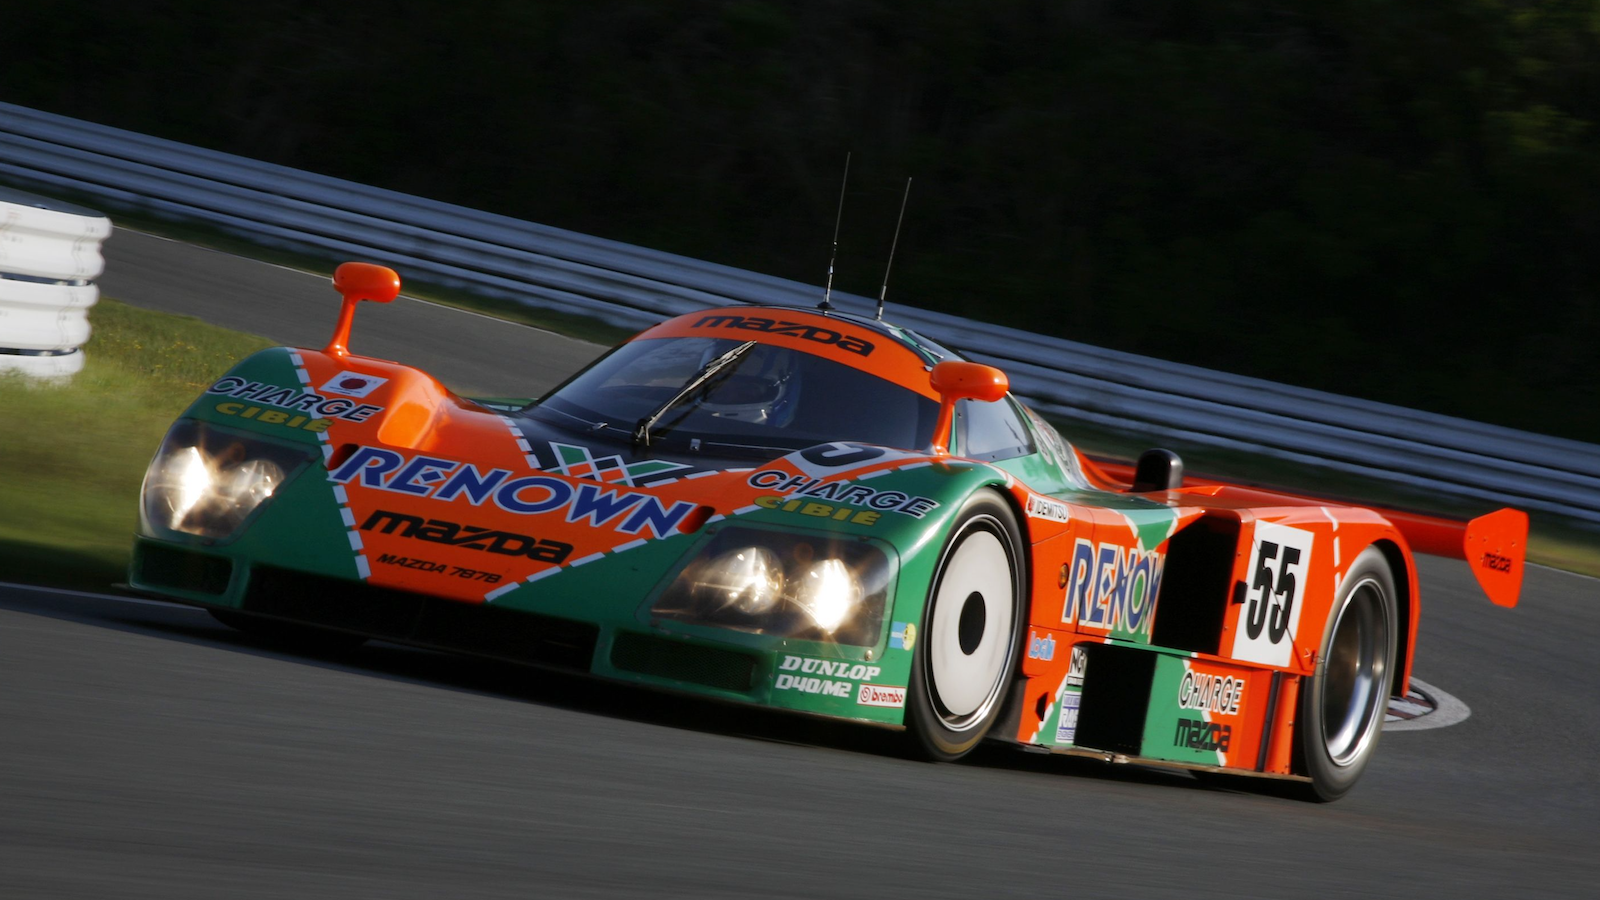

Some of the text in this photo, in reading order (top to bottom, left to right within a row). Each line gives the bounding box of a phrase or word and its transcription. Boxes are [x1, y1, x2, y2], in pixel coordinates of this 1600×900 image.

[206, 376, 385, 423] CHARGE
[327, 445, 699, 539] RENOWN
[747, 470, 940, 519] CHARGE
[1035, 501, 1068, 521] IDEMITSU
[376, 553, 502, 584] MAZDA 787B
[1246, 540, 1301, 645] 55
[775, 674, 852, 697] D40/M2
[779, 655, 881, 681] DUNLOP
[871, 688, 903, 704] brembo
[1178, 668, 1245, 716] CHARGE
